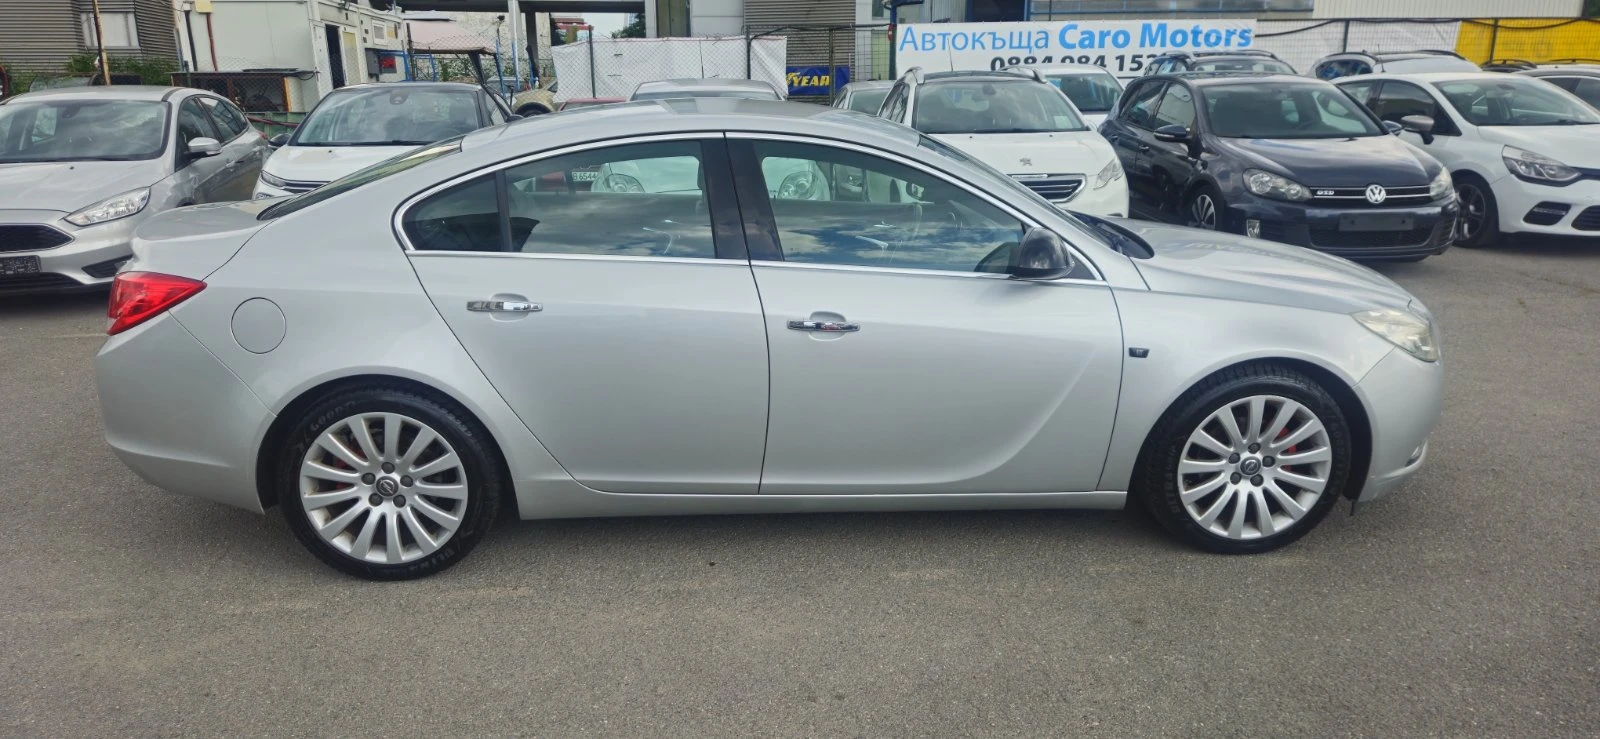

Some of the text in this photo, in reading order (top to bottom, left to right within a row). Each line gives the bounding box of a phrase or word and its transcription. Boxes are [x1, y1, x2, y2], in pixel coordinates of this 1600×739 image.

[899, 22, 1252, 54] Автокъща Caro Motors
[1115, 54, 1157, 72] 15
